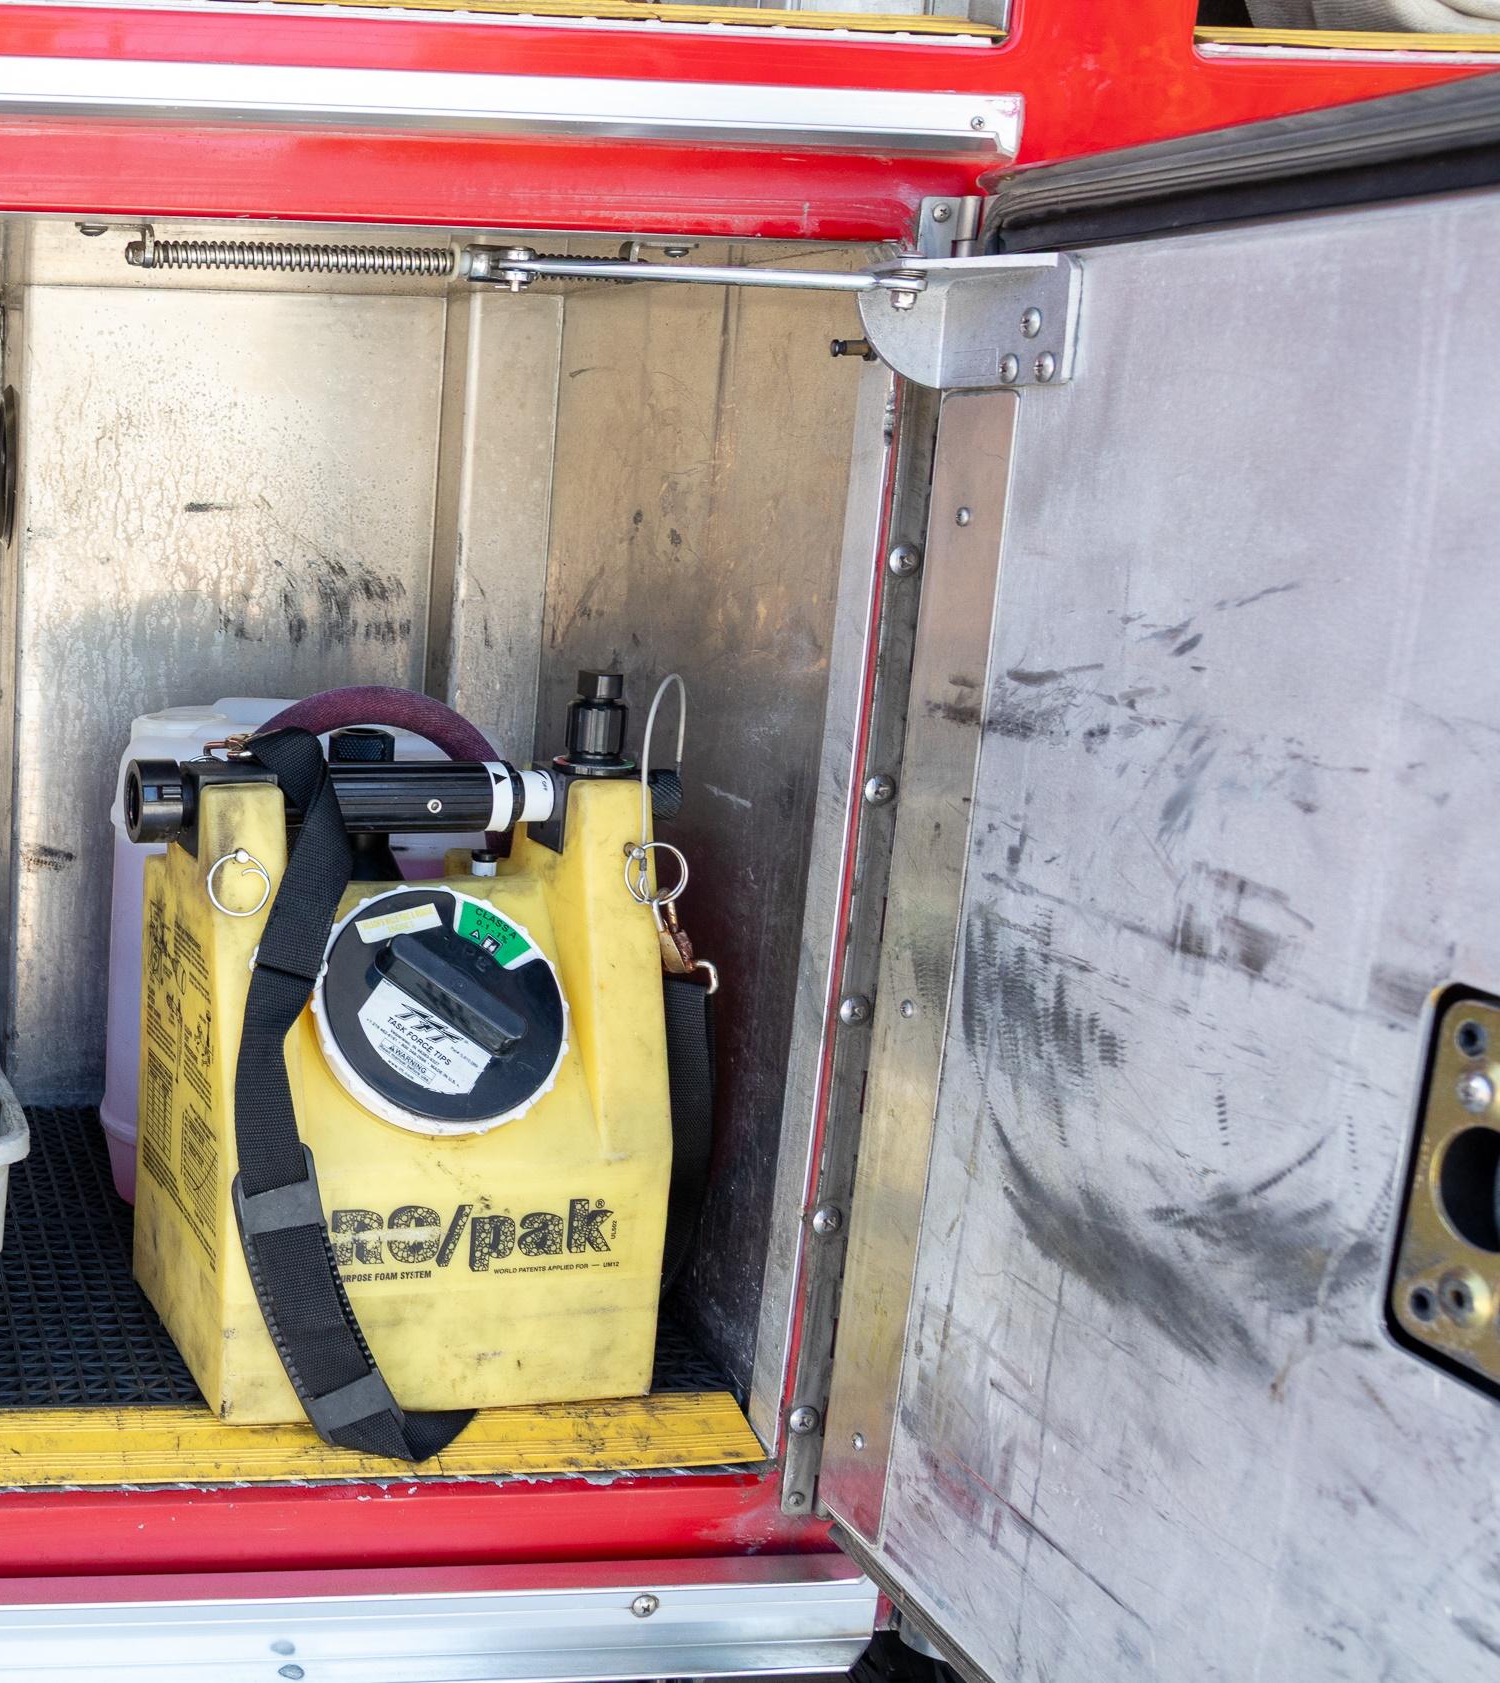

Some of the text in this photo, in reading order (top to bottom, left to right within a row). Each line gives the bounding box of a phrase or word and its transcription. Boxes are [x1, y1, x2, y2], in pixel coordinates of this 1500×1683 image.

[476, 907, 517, 940] CLASS A
[386, 1016, 407, 1033] TASK
[405, 1030, 433, 1052] FORCE
[433, 1050, 452, 1066] TIPS
[394, 1048, 427, 1074] WARNING
[340, 1270, 432, 1283] URPOSE FOAM SYSTEM
